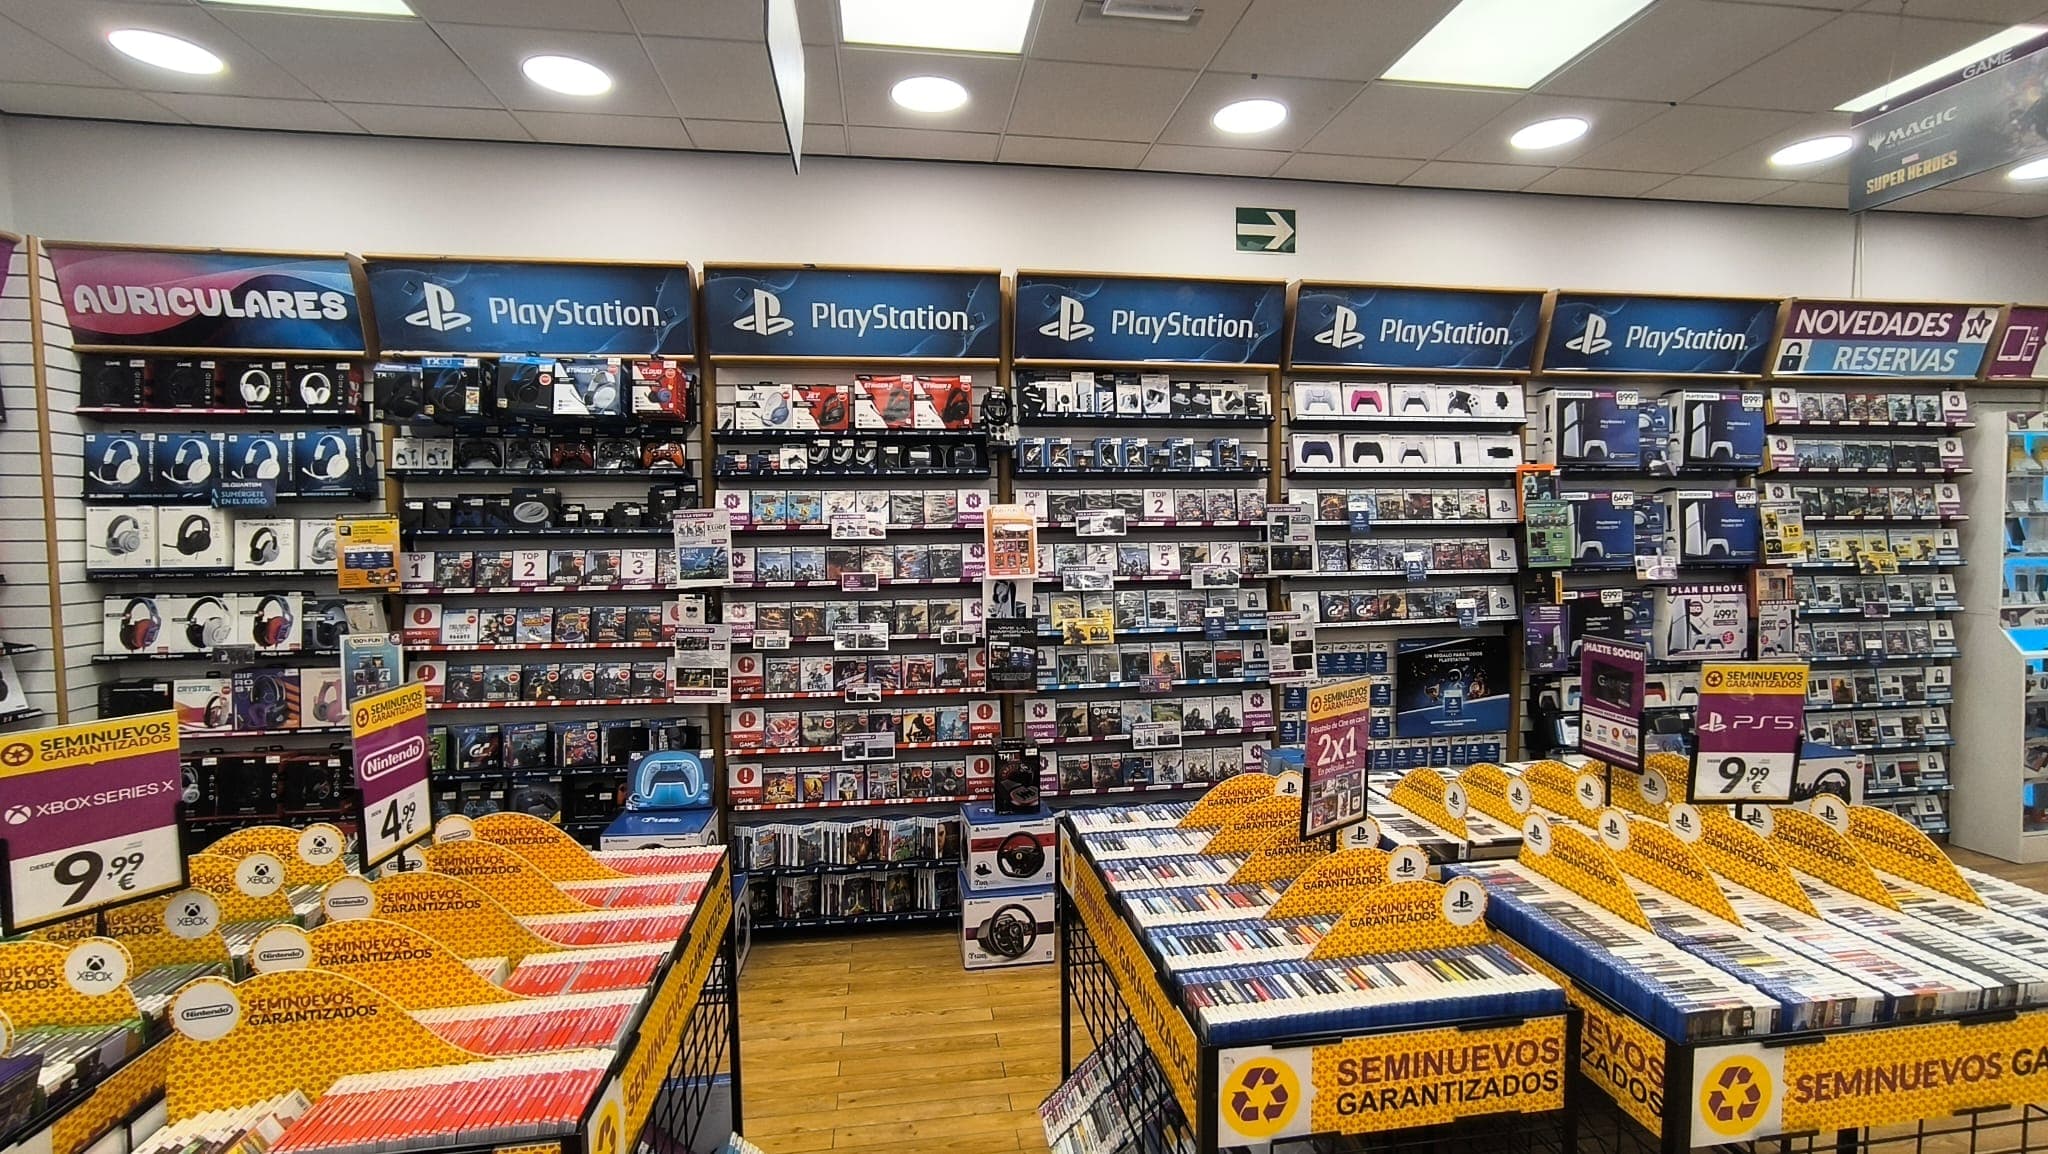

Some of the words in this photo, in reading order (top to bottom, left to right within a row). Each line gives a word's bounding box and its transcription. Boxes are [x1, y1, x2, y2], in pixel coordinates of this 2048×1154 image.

[1962, 50, 2013, 79] GAME
[1884, 106, 1957, 144] MAGIC
[1866, 168, 1905, 195] SUPER
[1907, 150, 1957, 181] HEROES
[73, 285, 347, 320] AURICULARES
[488, 297, 659, 334] PlayStation
[811, 302, 968, 337] PlayStation
[1795, 309, 1953, 338] NOVEDADES
[1111, 310, 1253, 343] PlayStation
[1380, 318, 1510, 351] PlayStation
[1625, 325, 1746, 356] PlayStation
[1832, 346, 1958, 372] RESERVAS
[221, 490, 264, 498] SUMÉRGETE
[1154, 500, 1164, 513] 2
[408, 554, 426, 562] TOP
[1160, 552, 1170, 566] 5
[1221, 551, 1231, 566] 6
[411, 563, 421, 579] 1
[523, 561, 535, 577] 2
[1671, 586, 1698, 594] PLAN
[1702, 584, 1743, 593] RENOVE
[1713, 609, 1730, 619] 499
[1612, 647, 1643, 661] SOCIO!
[1726, 680, 1802, 688] GARANTIZADOS
[1727, 671, 1803, 681] SEMINUEVOS
[370, 690, 422, 717] SEMINUEVOS
[1323, 686, 1367, 704] SEMINUEVOS
[1323, 696, 1367, 712] GARANTIZADOS
[371, 700, 423, 724] GARANTIZADOS
[1733, 715, 1795, 730] PS5
[40, 721, 171, 751] SEMINUEVOS
[40, 733, 171, 762] GARANTIZADOS
[1317, 726, 1357, 767] 2x1
[367, 742, 419, 776] Nintendo
[1718, 757, 1746, 793] 9
[1219, 788, 1270, 797] SEMINUEVOS
[1751, 781, 1762, 793] €
[36, 795, 91, 818] XBOX
[93, 783, 158, 806] SERIES
[161, 779, 175, 792] X
[381, 798, 402, 843] 4
[1245, 811, 1300, 821] SEMINUEVOS
[406, 819, 414, 834] €
[480, 827, 545, 837] SEMINUEVOS
[1777, 820, 1841, 850] SEMINUEVOS
[1854, 819, 1921, 848] SEMINUEVOS
[308, 847, 333, 855] XBOX
[1633, 835, 1689, 865] SEMINUEVOS
[1704, 827, 1764, 857] SEMINUEVOS
[1776, 831, 1856, 866] GARANTIZADOS
[1853, 829, 1939, 864] GARANTIZADOS
[433, 856, 504, 867] SEMINUEVOS
[1553, 838, 1605, 869] SEMINUEVOS
[1632, 844, 1703, 881] GARANTIZADOS
[1704, 837, 1778, 873] GARANTIZADOS
[28, 861, 55, 872] DESDE
[1317, 864, 1382, 879] SEMINUEVOS
[1552, 849, 1617, 886] GARANTIZADOS
[54, 850, 103, 907] 9
[117, 872, 136, 891] €
[1303, 875, 1383, 890] GARANTIZADOS
[381, 890, 463, 902] SEMINUEVOS
[381, 900, 481, 915] GARANTIZADOS
[1365, 900, 1436, 916] SEMINUEVOS
[177, 916, 208, 926] XBOX
[1350, 910, 1437, 928] GARANTIZADOS
[318, 937, 410, 952] SEMINUEVOS
[261, 950, 303, 960] Nintendo
[319, 948, 433, 967] GARANTIZADOS
[77, 971, 113, 982] XBOX
[1075, 872, 1119, 957] SEMINUEVOS
[1119, 951, 1197, 1097] GARANTIZADOS
[249, 993, 354, 1012] SEMINUEVOS
[628, 981, 689, 1116] SEMINUEVOS
[689, 880, 731, 985] GARANTIZADOS
[185, 1007, 229, 1019] Nintendo
[249, 1004, 378, 1026] GARANTIZADOS
[1337, 1037, 1559, 1088] SEMINUEVOS
[1795, 1053, 2001, 1102] SEMINUEVOS
[1336, 1070, 1558, 1115] GARANTIZADOS
